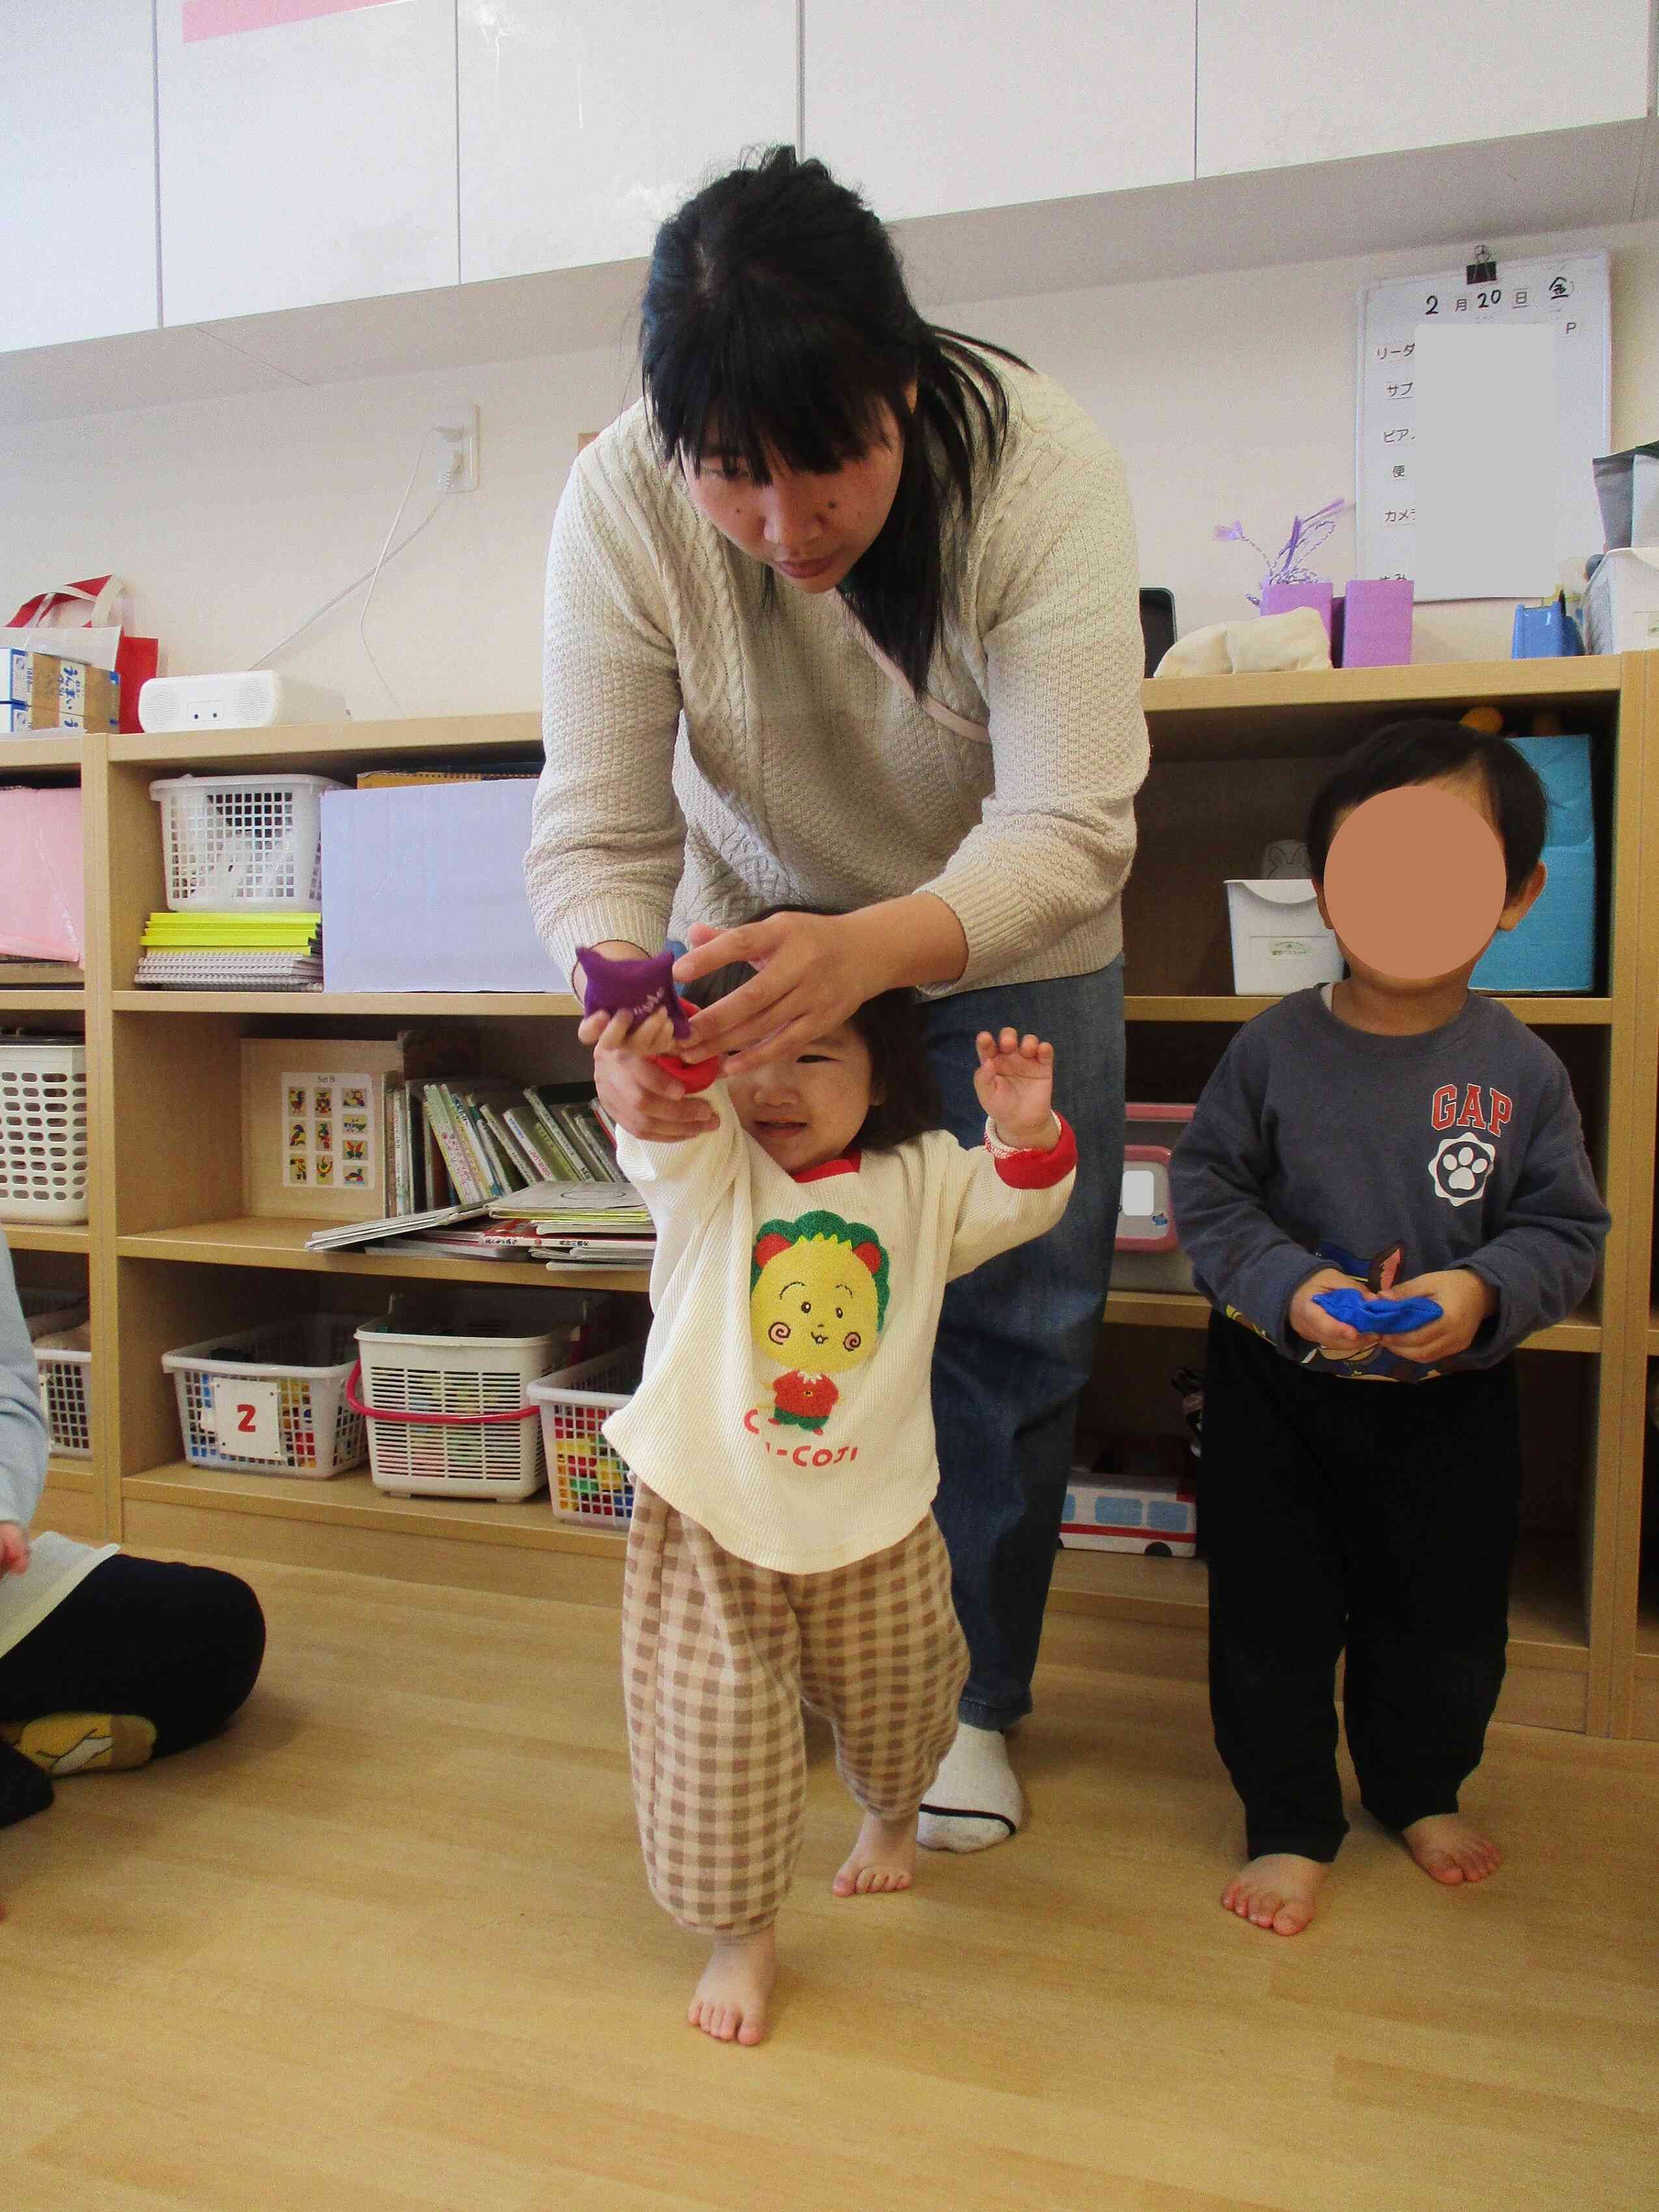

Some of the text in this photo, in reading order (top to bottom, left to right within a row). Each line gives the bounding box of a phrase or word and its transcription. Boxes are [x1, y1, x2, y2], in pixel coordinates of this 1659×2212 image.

[1425, 295, 1438, 315] 2
[1455, 298, 1467, 312] 月
[1477, 290, 1502, 308] 20
[1515, 291, 1528, 304] 日
[1384, 429, 1415, 443] ピア
[1431, 1083, 1513, 1138] GAP
[236, 1403, 256, 1433] 2
